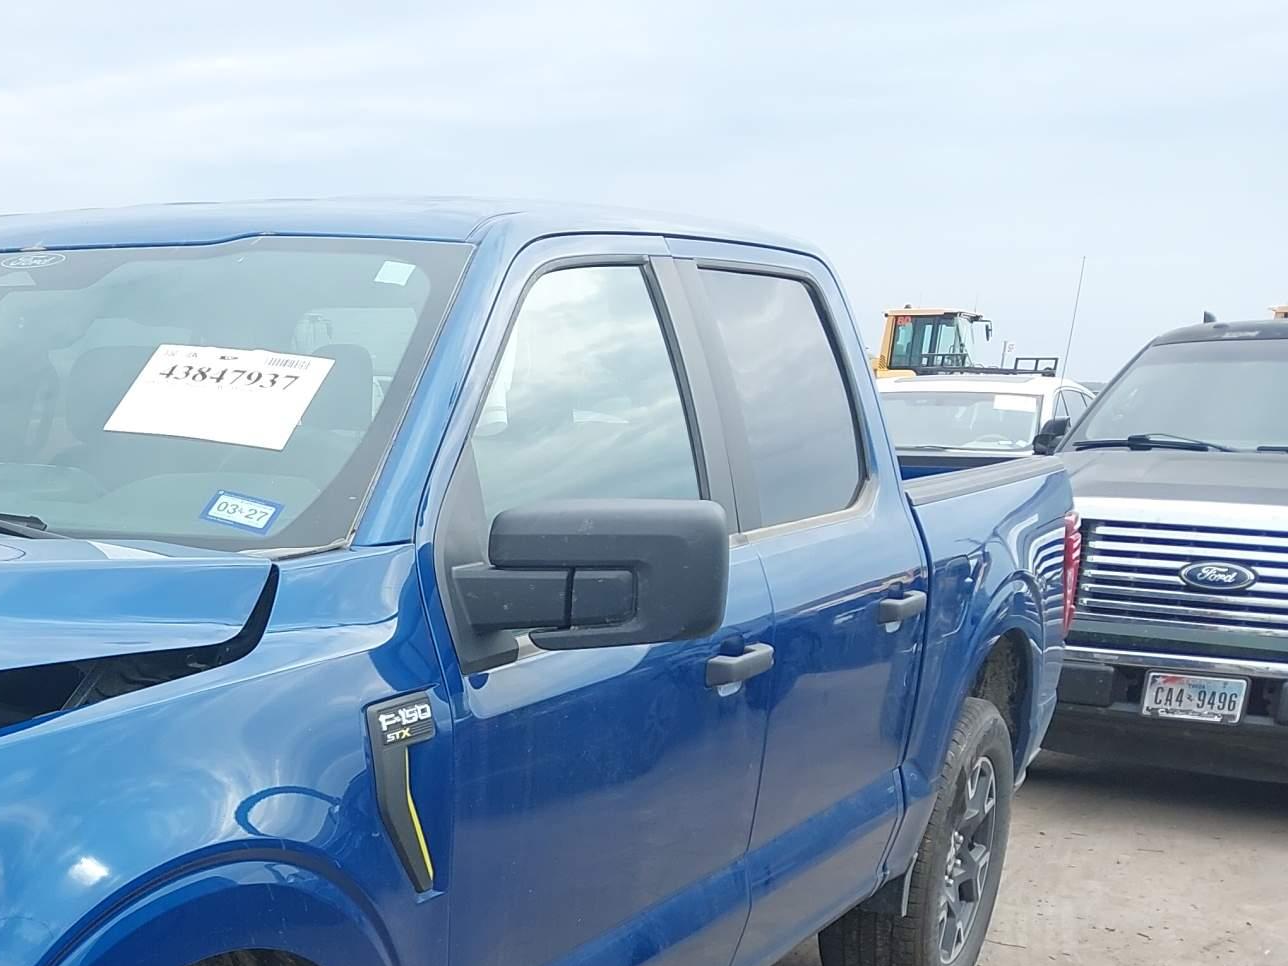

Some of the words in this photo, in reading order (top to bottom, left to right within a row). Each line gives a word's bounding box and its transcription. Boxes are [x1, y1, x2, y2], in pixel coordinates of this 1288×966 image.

[159, 364, 301, 391] 43847937
[1197, 565, 1237, 584] Ford
[378, 703, 432, 732] F-150
[386, 727, 413, 743] STX
